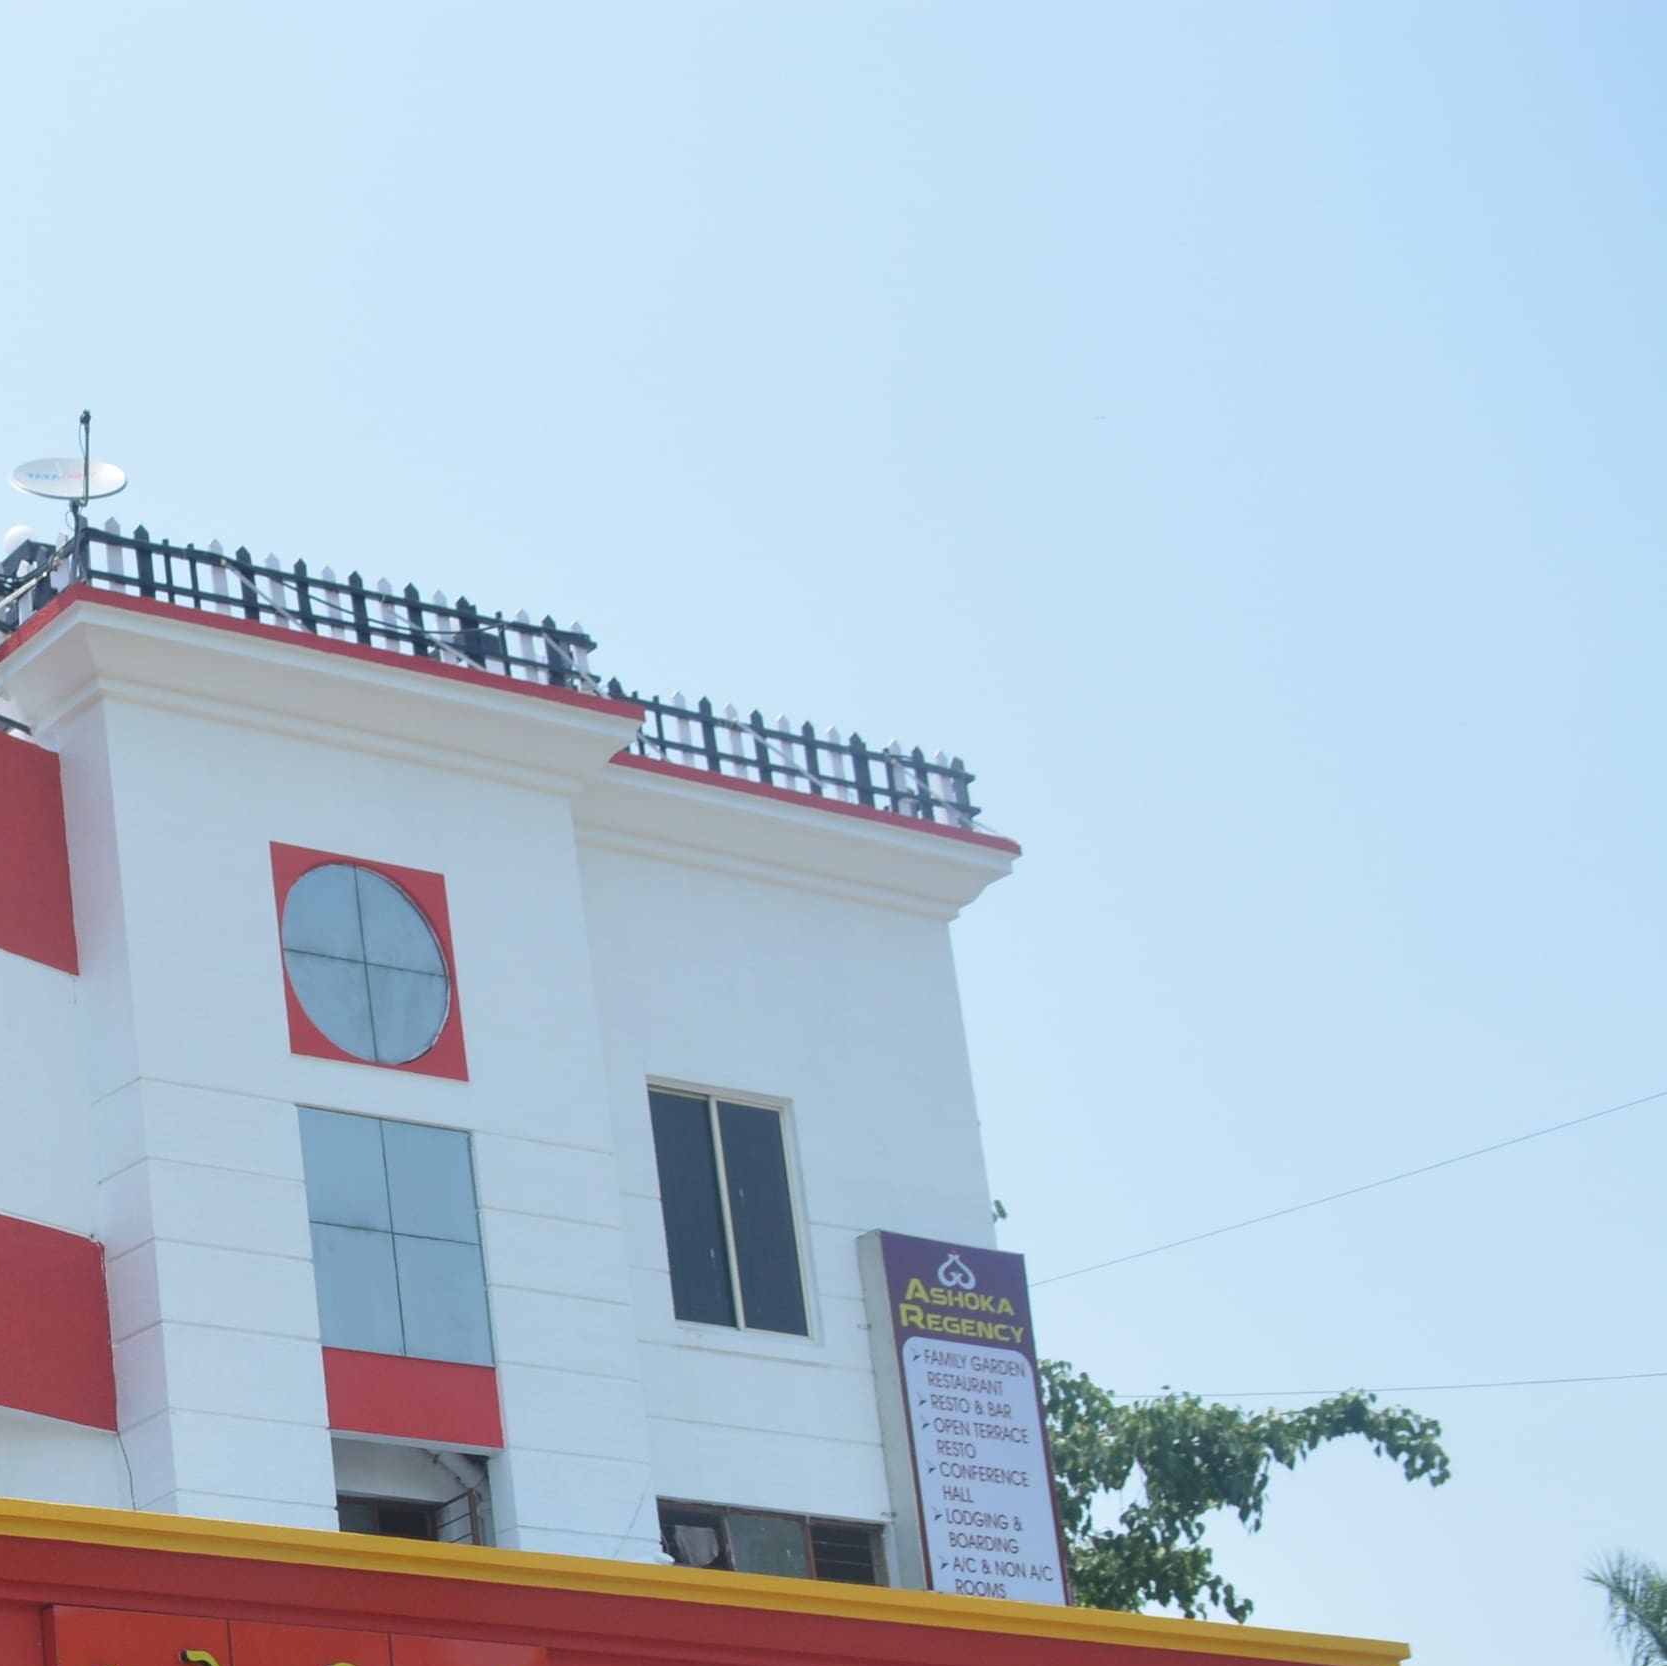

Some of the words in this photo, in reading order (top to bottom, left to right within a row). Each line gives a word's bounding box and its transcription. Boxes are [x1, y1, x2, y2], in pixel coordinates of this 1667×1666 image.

[905, 1278, 1015, 1316] ASHOKA
[899, 1303, 1024, 1343] REGENCY
[924, 1349, 966, 1369] FAMILY
[970, 1356, 1025, 1377] GARDEN
[927, 1371, 1003, 1396] RESTAURANT
[930, 1394, 970, 1413] RESTO
[974, 1400, 984, 1415] &
[988, 1401, 1012, 1418] BAR
[933, 1417, 970, 1436] OPEN
[973, 1422, 1029, 1444] TERRACE
[937, 1440, 976, 1459] RESTO
[939, 1461, 1030, 1487] CONFERENCE
[942, 1485, 974, 1503] HALL
[945, 1508, 1009, 1530] LODGING
[1013, 1516, 1023, 1532] &
[948, 1531, 1019, 1554] BOARDING
[953, 1556, 977, 1574] A/C
[981, 1559, 992, 1575] &
[995, 1561, 1027, 1578] NON
[1030, 1565, 1054, 1582] A/C
[955, 1578, 1007, 1599] ROOMS
